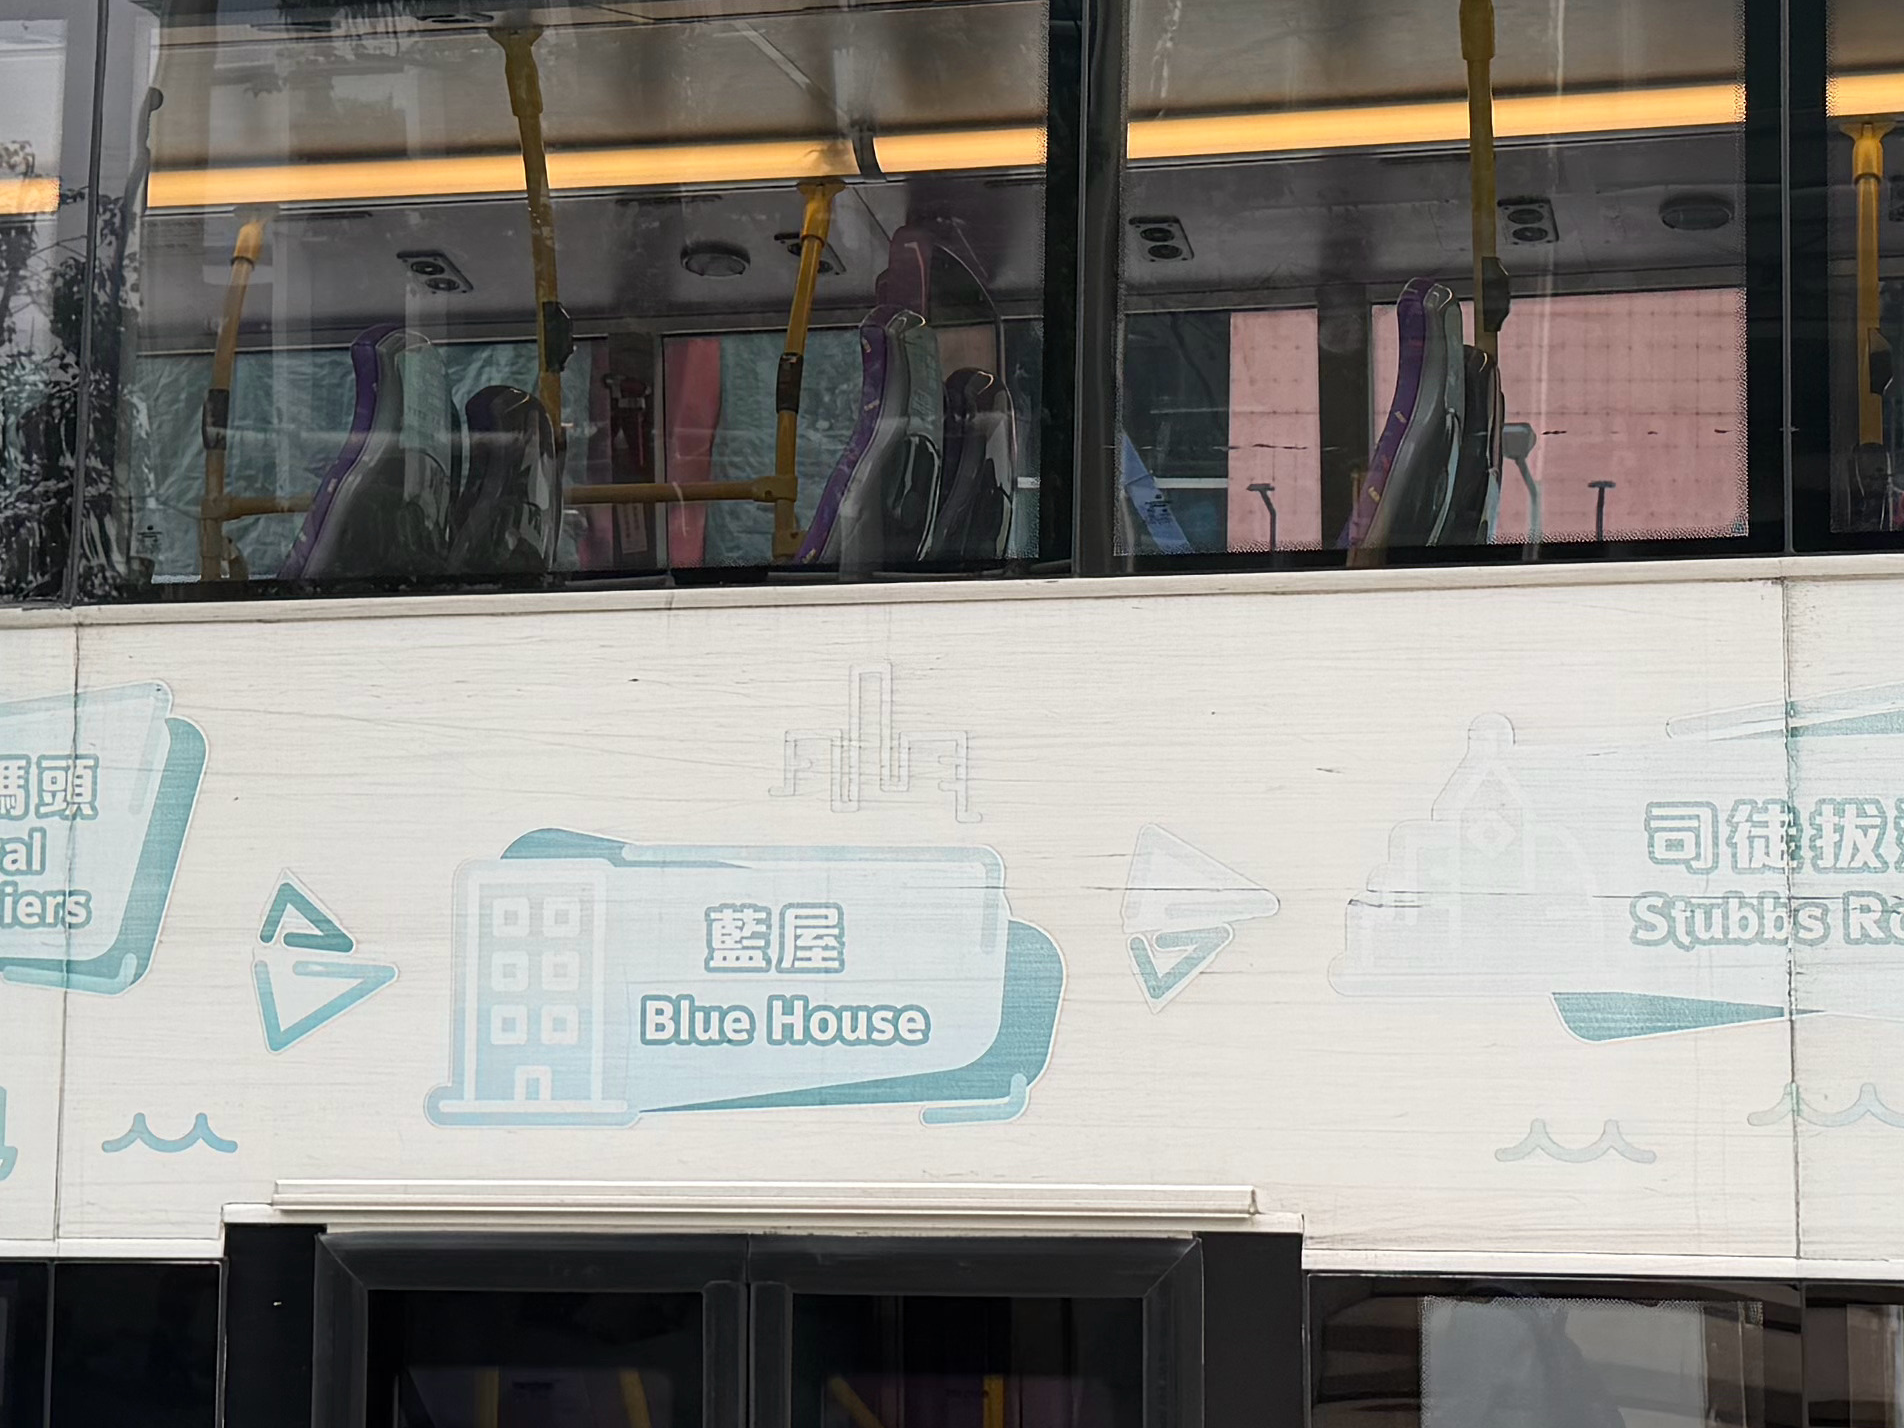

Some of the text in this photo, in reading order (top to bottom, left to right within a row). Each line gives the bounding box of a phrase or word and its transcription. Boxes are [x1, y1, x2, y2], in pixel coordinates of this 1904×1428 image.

[702, 903, 847, 972] 藍屋
[1630, 891, 1831, 951] Stubbs
[640, 994, 930, 1047] Blue House
